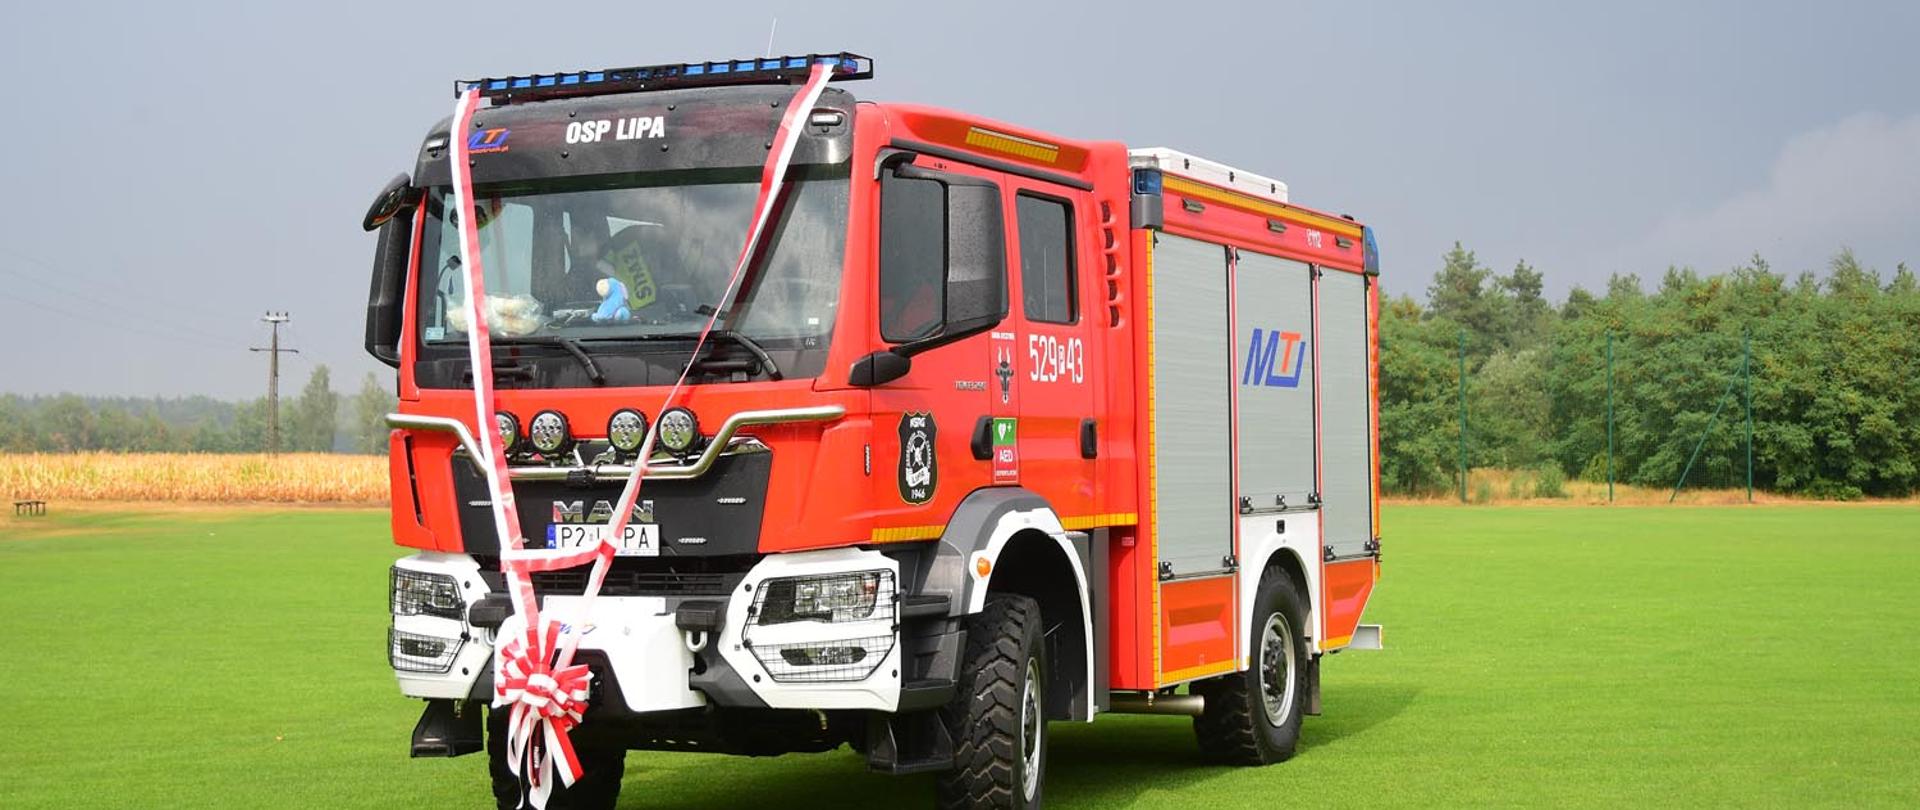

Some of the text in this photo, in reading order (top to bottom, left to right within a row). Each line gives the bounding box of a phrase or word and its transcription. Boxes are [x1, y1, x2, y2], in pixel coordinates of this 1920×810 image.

[566, 116, 665, 144] OSP LIPA
[553, 500, 654, 523] MAN
